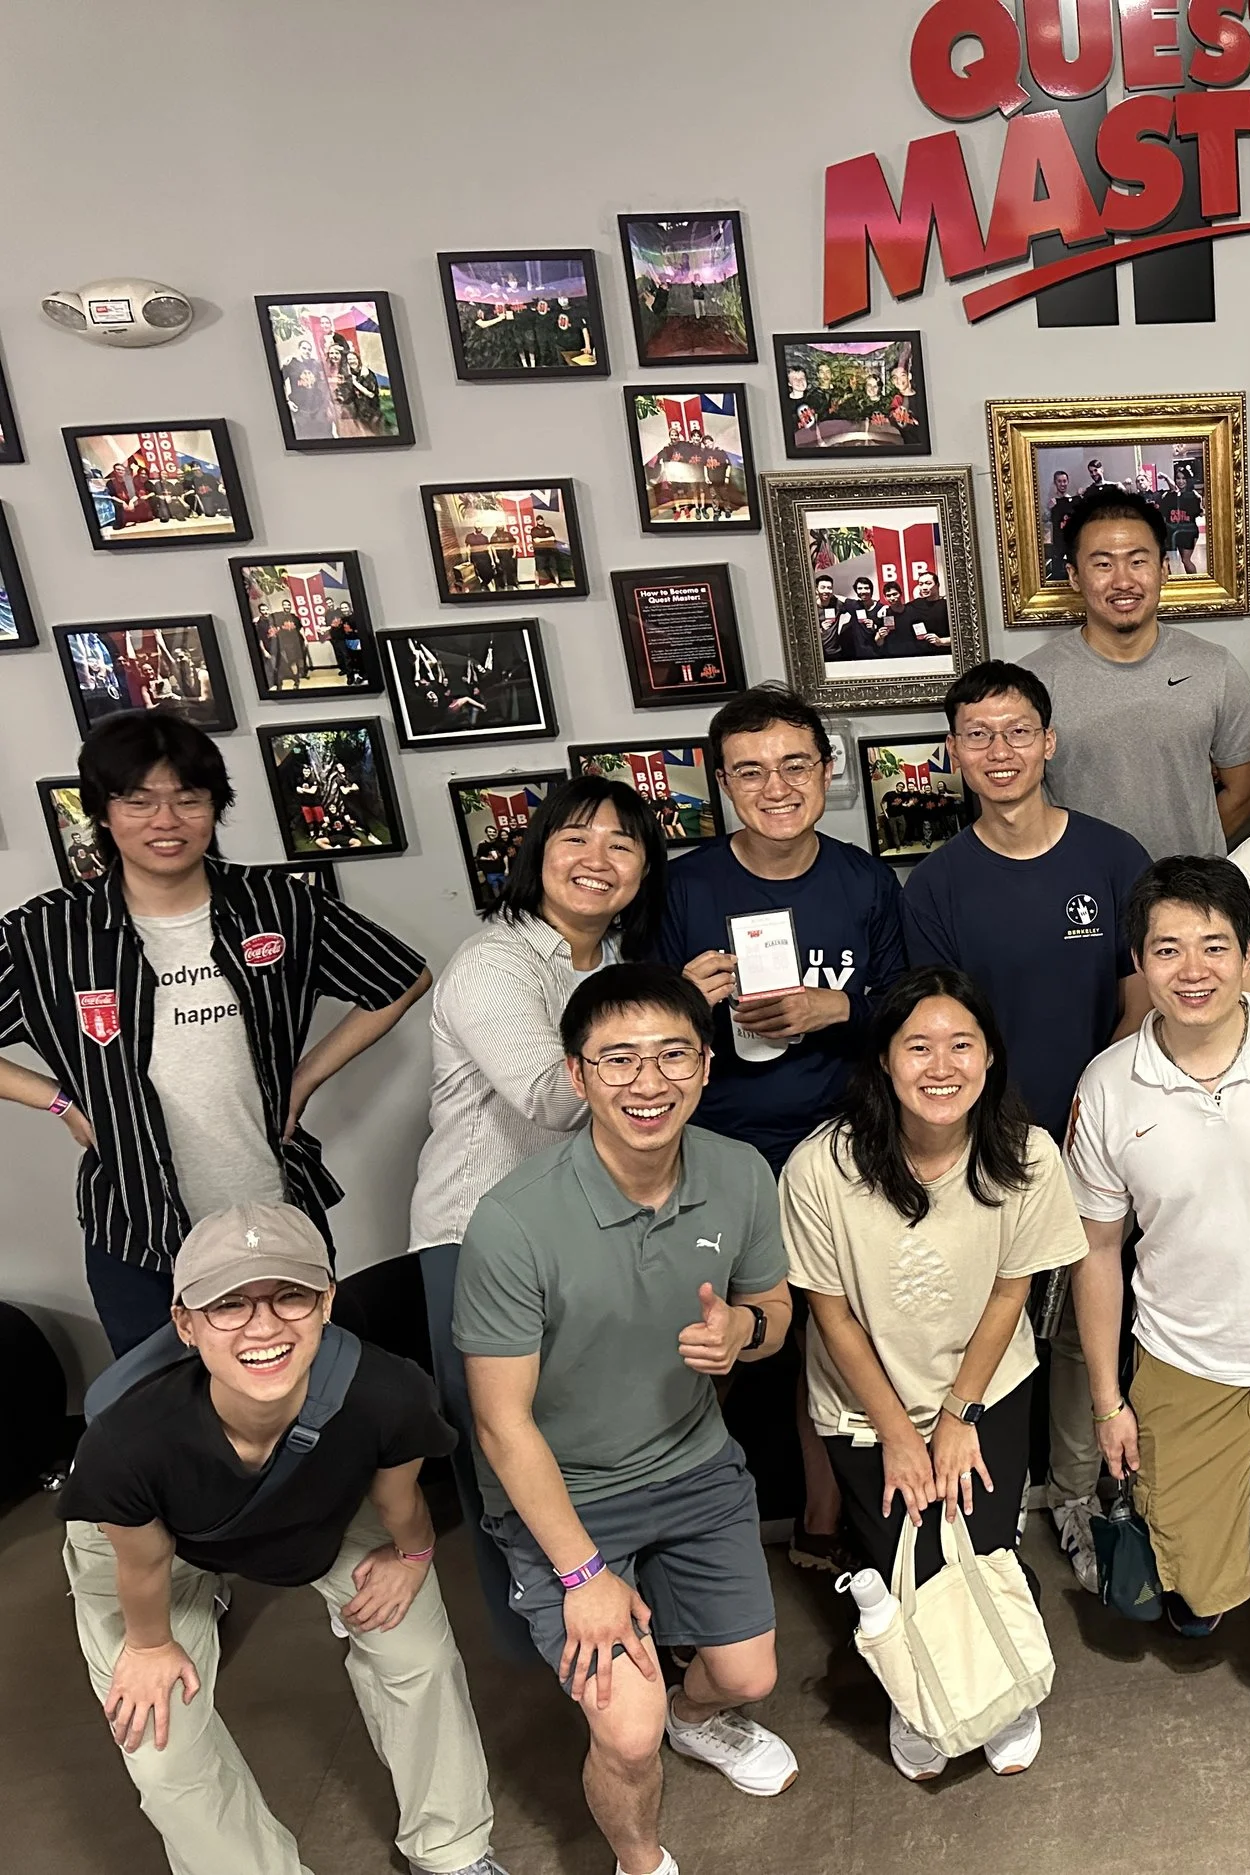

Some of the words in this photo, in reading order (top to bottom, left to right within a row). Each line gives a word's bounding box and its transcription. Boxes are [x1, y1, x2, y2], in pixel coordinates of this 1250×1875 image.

[640, 590, 659, 598] How
[669, 587, 699, 596] Become
[648, 595, 671, 604] Quest
[672, 594, 701, 603] Master:
[1067, 928, 1100, 936] BERKELEY
